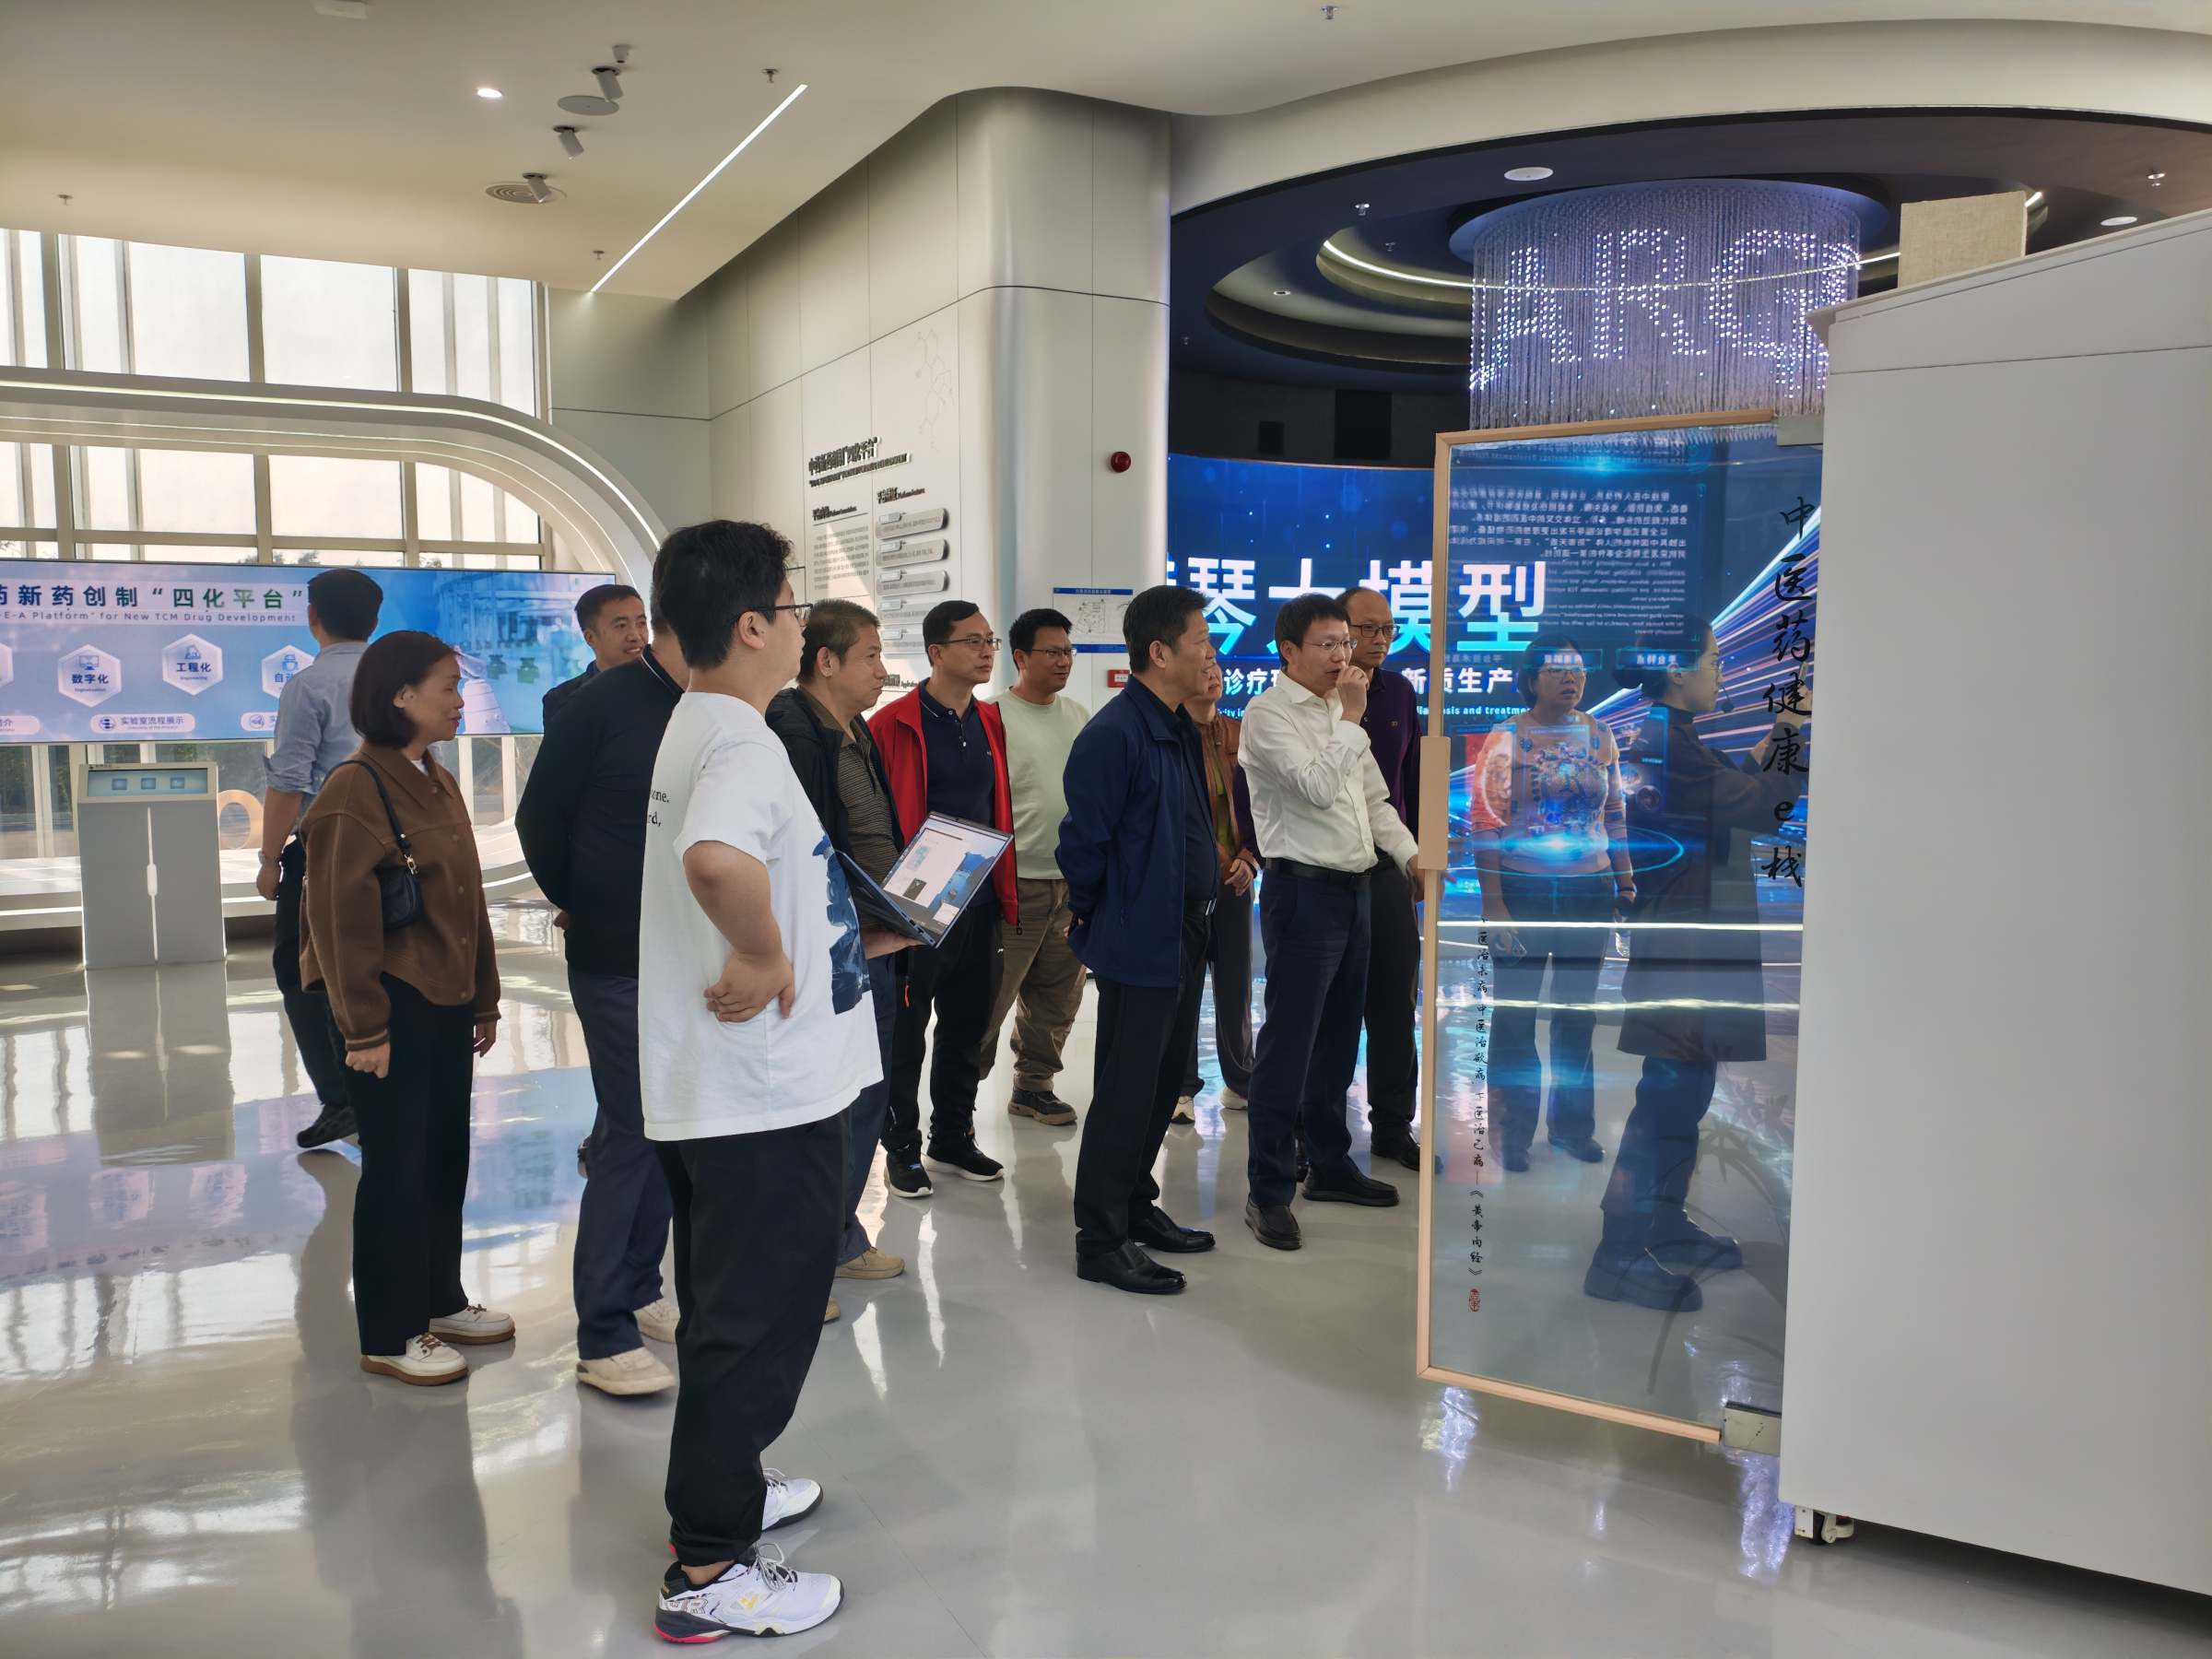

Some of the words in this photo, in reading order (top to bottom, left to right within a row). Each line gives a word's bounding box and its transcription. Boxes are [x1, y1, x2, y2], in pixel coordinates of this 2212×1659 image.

[1167, 558, 1547, 656] 琴大模型
[100, 611, 119, 620] for
[184, 613, 213, 622] Drug
[218, 613, 296, 623] Development
[176, 663, 212, 673] 工程化
[71, 674, 109, 684] 数字化
[1463, 706, 1482, 715] and
[1485, 706, 1531, 715] treatme
